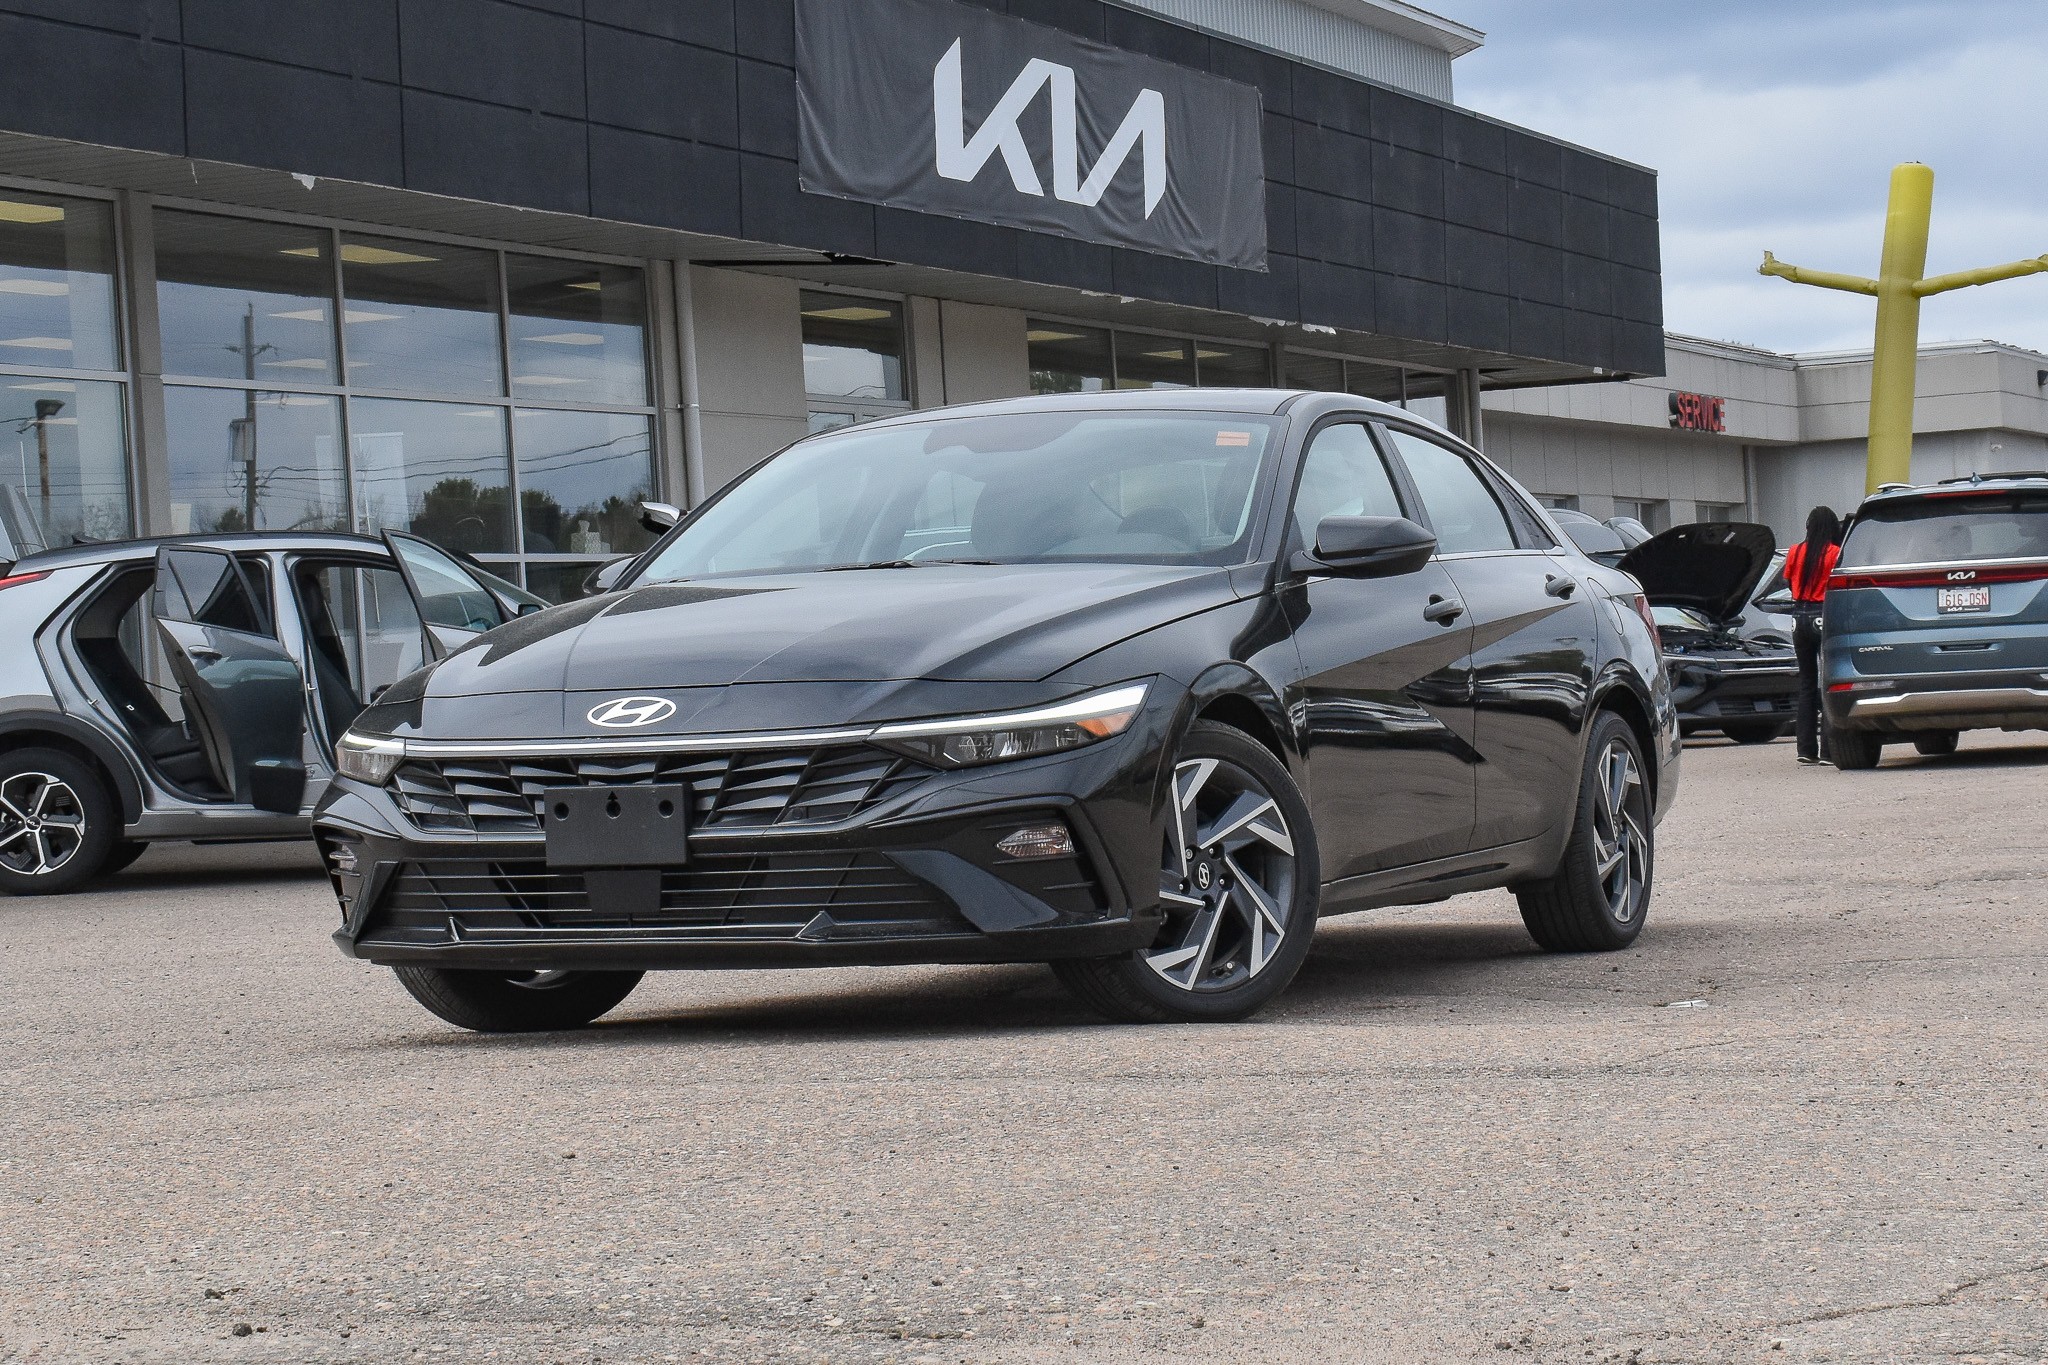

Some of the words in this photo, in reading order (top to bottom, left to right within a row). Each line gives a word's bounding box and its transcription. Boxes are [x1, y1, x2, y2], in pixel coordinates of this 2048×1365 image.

[934, 36, 1167, 220] KIA
[1676, 391, 1726, 432] SERVICE
[1947, 571, 1975, 580] KIA
